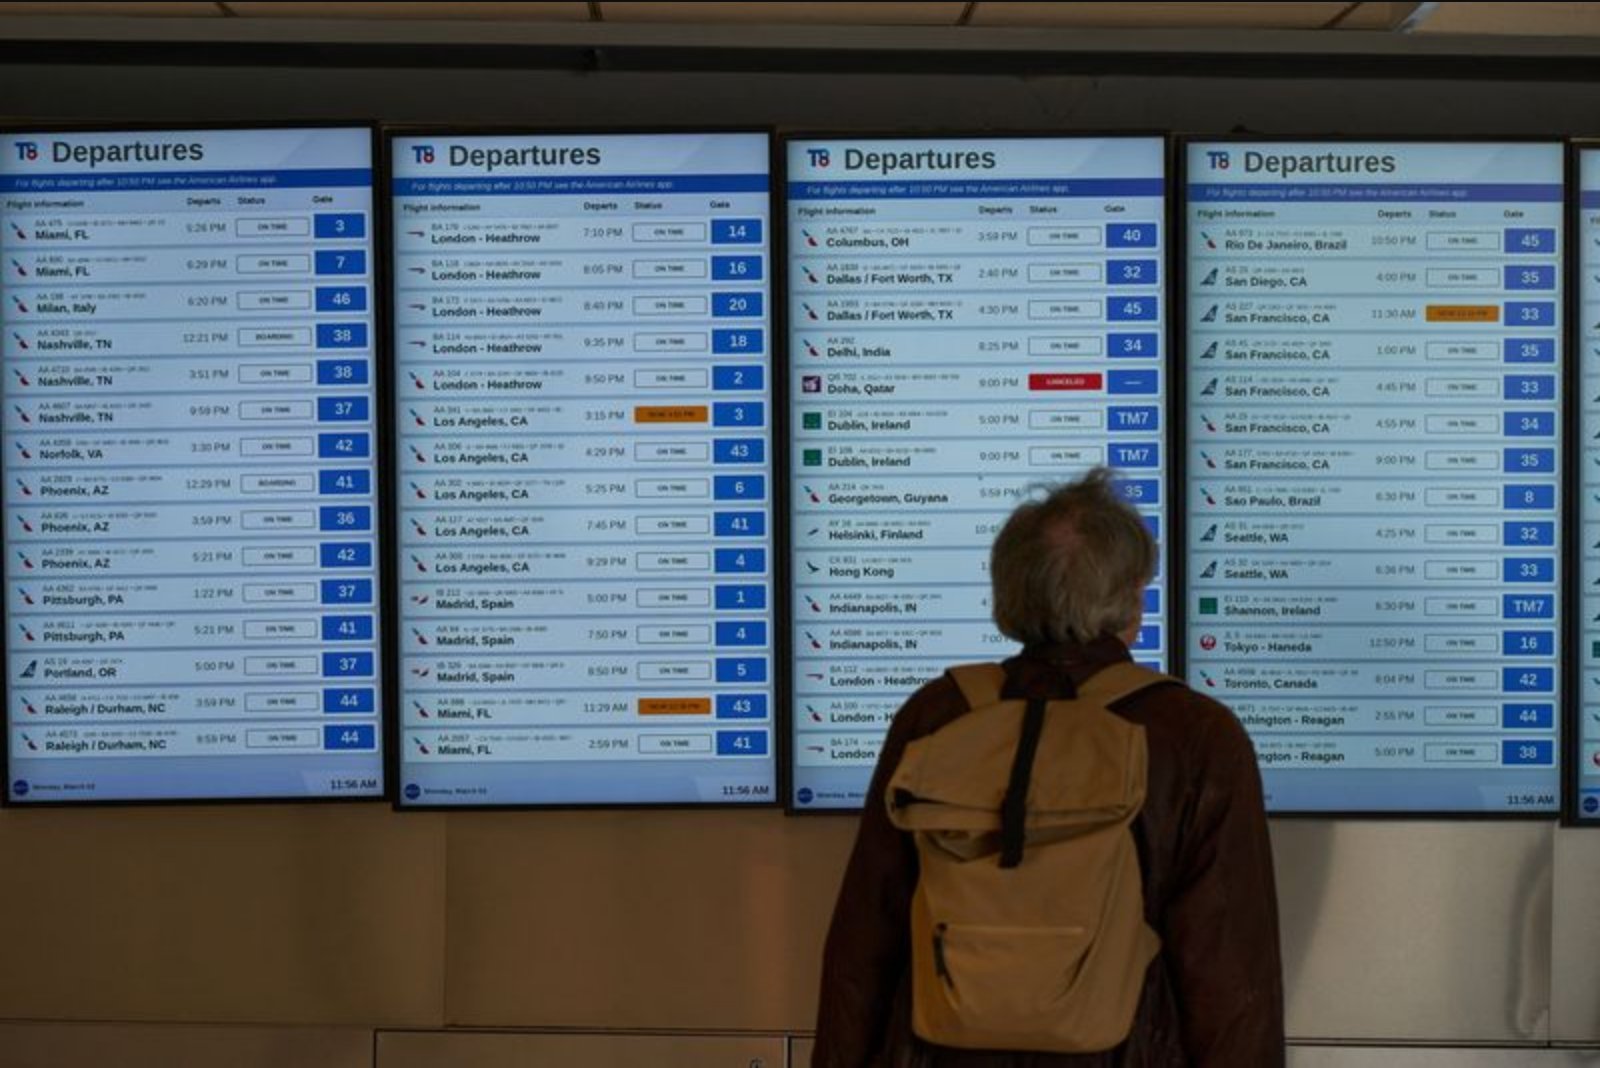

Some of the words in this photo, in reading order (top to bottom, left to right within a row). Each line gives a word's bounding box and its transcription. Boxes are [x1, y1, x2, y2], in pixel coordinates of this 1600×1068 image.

[14, 141, 38, 161] T8
[52, 141, 204, 168] Departures
[411, 145, 435, 164] T8
[450, 145, 601, 172] Departures
[807, 148, 831, 168] T8
[845, 148, 996, 176] Departures
[1206, 151, 1230, 170] T8
[1244, 151, 1396, 178] Departures
[335, 219, 345, 232] 3
[729, 225, 746, 237] 14
[35, 229, 72, 241] Miami,
[74, 229, 89, 240] FL
[605, 227, 623, 237] PM
[1123, 229, 1141, 241] 40
[431, 233, 476, 245] London
[485, 232, 541, 243] Heathrow
[825, 237, 889, 248] Columbus,
[890, 237, 909, 247] OH
[1521, 234, 1540, 247] 45
[1225, 239, 1245, 250] Rio
[1247, 239, 1264, 250] De
[1266, 239, 1313, 251] Janeiro,
[1314, 239, 1347, 250] Brazil
[1123, 265, 1141, 279] 32
[1521, 271, 1539, 284] 35
[826, 273, 865, 285] Dallas
[871, 273, 895, 283] Fort
[896, 273, 935, 284] Worth,
[937, 273, 953, 283] TX
[1225, 276, 1248, 287] San
[1250, 276, 1287, 289] Diego,
[1289, 276, 1308, 287] CA
[333, 292, 351, 305] 46
[36, 303, 70, 314] Milan,
[73, 302, 97, 315] Italy
[1521, 307, 1539, 321] 33
[1224, 313, 1248, 323] San
[1249, 313, 1310, 324] Francisco,
[1311, 313, 1330, 323] CA
[211, 333, 229, 342] PM
[334, 329, 351, 342] 38
[37, 339, 93, 350] Nashville,
[95, 339, 112, 349] TN
[1124, 339, 1142, 351] 34
[827, 347, 860, 358] Delhi,
[862, 347, 891, 357] India
[734, 371, 743, 384] 2
[433, 379, 478, 391] London
[487, 379, 543, 390] Heathrow
[827, 383, 862, 395] Doha,
[863, 383, 895, 396] Qatar
[735, 407, 744, 421] 3
[1117, 411, 1149, 425] TM7
[433, 417, 456, 427] Los
[457, 416, 509, 429] Angeles,
[510, 415, 529, 427] CA
[827, 420, 869, 432] Dublin,
[871, 419, 911, 430] Ireland
[335, 439, 353, 451] 42
[39, 448, 85, 460] Norfolk,
[87, 449, 103, 459] VA
[1399, 455, 1416, 464] PM
[1521, 453, 1539, 467] 35
[1224, 459, 1248, 470] San
[1249, 459, 1310, 470] Francisco,
[1311, 459, 1330, 469] CA
[214, 479, 231, 488] PM
[336, 475, 353, 488] 41
[39, 485, 90, 497] Phoenix,
[92, 485, 109, 496] AZ
[1525, 490, 1534, 503] 8
[828, 493, 901, 506] Georgetown,
[903, 493, 949, 505] Guyana
[1224, 496, 1247, 507] Sao
[1249, 495, 1286, 507] Paulo,
[1287, 495, 1321, 507] Brazil
[731, 518, 749, 530] 41
[435, 526, 457, 537] Los
[459, 525, 509, 539] Angeles,
[511, 525, 529, 536] CA
[828, 530, 878, 541] Helsinki,
[880, 529, 924, 540] Finland
[829, 567, 861, 579] Hong
[863, 567, 895, 579] Kong
[1224, 569, 1267, 580] Seattle,
[1268, 569, 1289, 579] WA
[1520, 563, 1538, 577] 33
[339, 585, 356, 597] 37
[42, 594, 106, 607] Pittsburgh,
[107, 594, 124, 604] PA
[1514, 600, 1544, 612] TM7
[829, 602, 903, 615] Indianapolis,
[904, 603, 917, 613] IN
[1224, 605, 1279, 617] Shannon,
[1281, 605, 1321, 616] Ireland
[736, 627, 746, 639] 4
[436, 635, 479, 647] Madrid,
[481, 634, 515, 648] Spain
[1521, 637, 1537, 649] 16
[1224, 641, 1259, 655] Tokyo
[1267, 642, 1312, 653] Haneda
[339, 657, 357, 671] 37
[43, 667, 96, 679] Portland,
[98, 667, 117, 678] OR
[1224, 678, 1271, 689] Toronto,
[1273, 678, 1318, 689] Canada
[1519, 673, 1537, 686] 42
[340, 694, 358, 706] 44
[44, 704, 89, 717] Raleigh
[97, 703, 146, 714] Durham,
[147, 703, 166, 713] NC
[733, 737, 751, 749] 41
[437, 745, 475, 756] Miami,
[477, 745, 492, 755] FL
[359, 779, 377, 789] AM
[751, 785, 770, 795] AM
